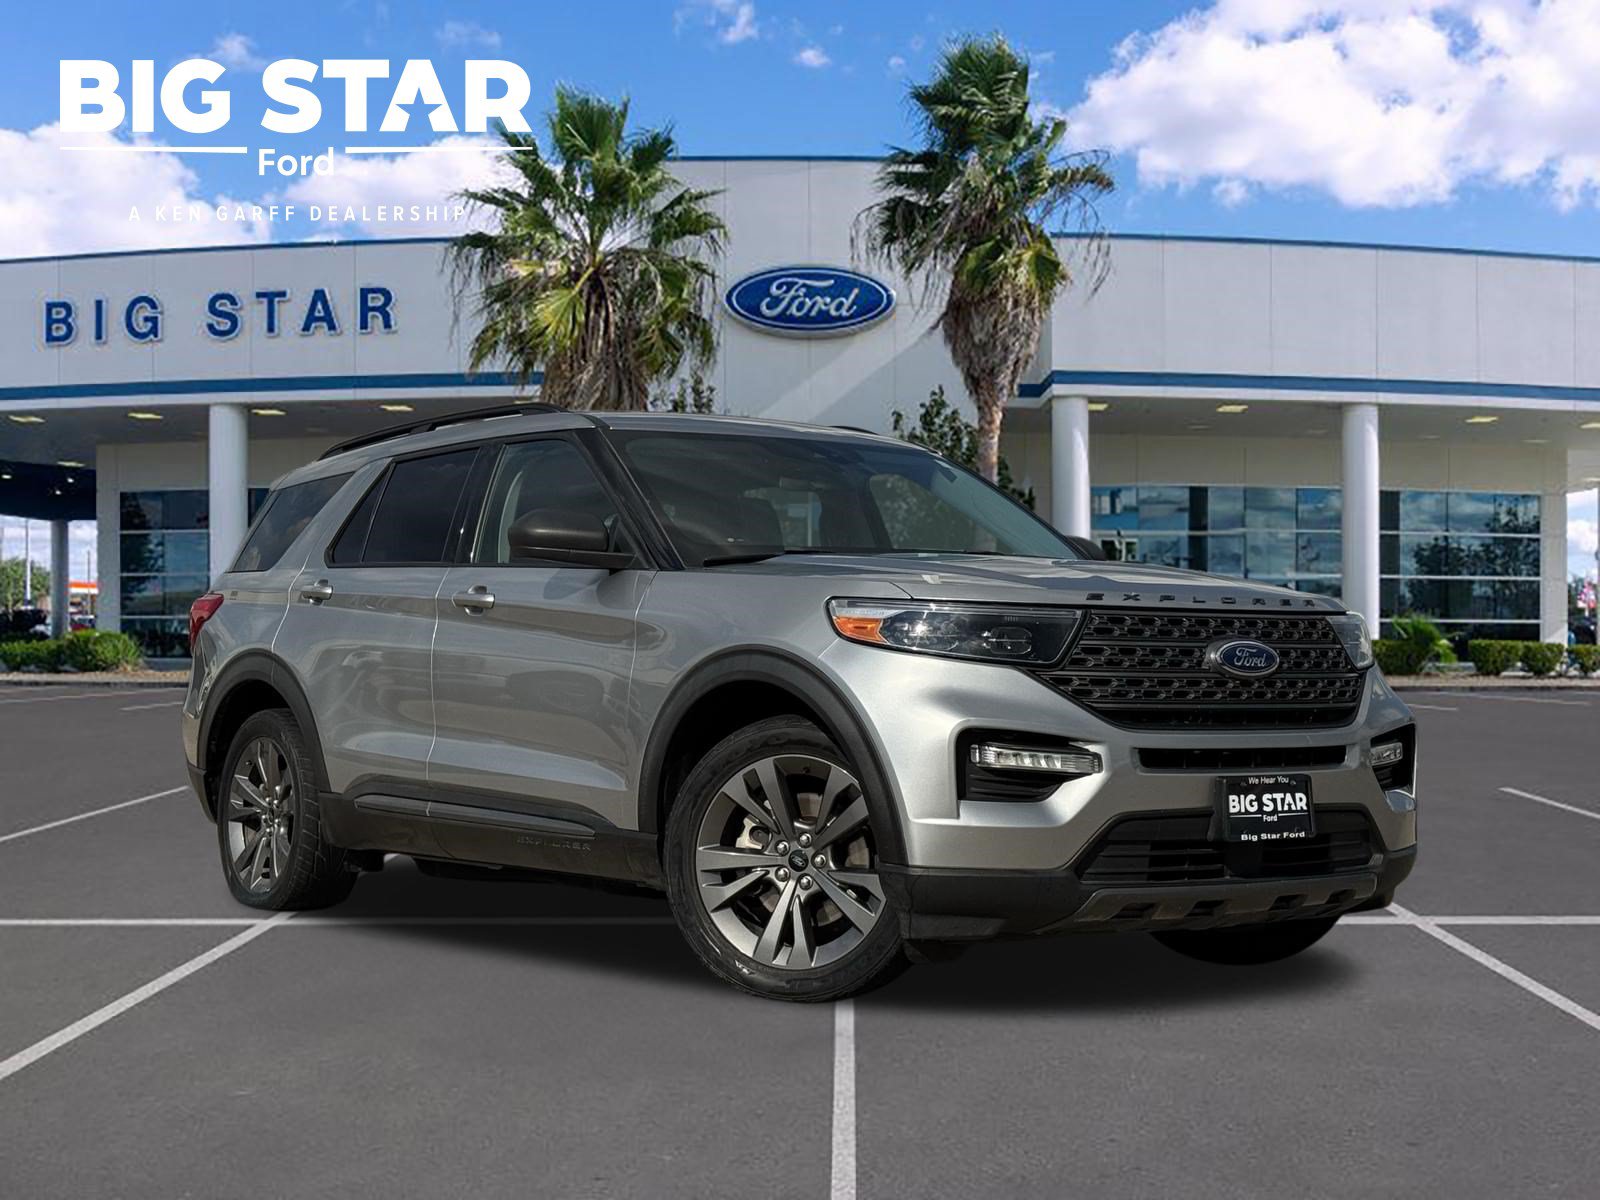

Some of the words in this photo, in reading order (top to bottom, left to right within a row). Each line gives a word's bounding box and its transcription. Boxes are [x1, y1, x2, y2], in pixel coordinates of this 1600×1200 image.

[760, 277, 859, 318] Ford
[45, 294, 161, 345] BIG
[205, 286, 398, 339] STAR
[1086, 592, 1316, 608] EXPLORER
[1233, 647, 1269, 668] Ford
[1248, 776, 1260, 785] We
[1260, 776, 1276, 784] Hear
[1277, 775, 1290, 783] You
[1228, 793, 1259, 813] BIG
[1262, 792, 1308, 812] STAR
[1263, 814, 1278, 822] Ford
[1241, 833, 1258, 841] Big
[1260, 832, 1280, 840] Star
[1283, 831, 1305, 839] Ford
